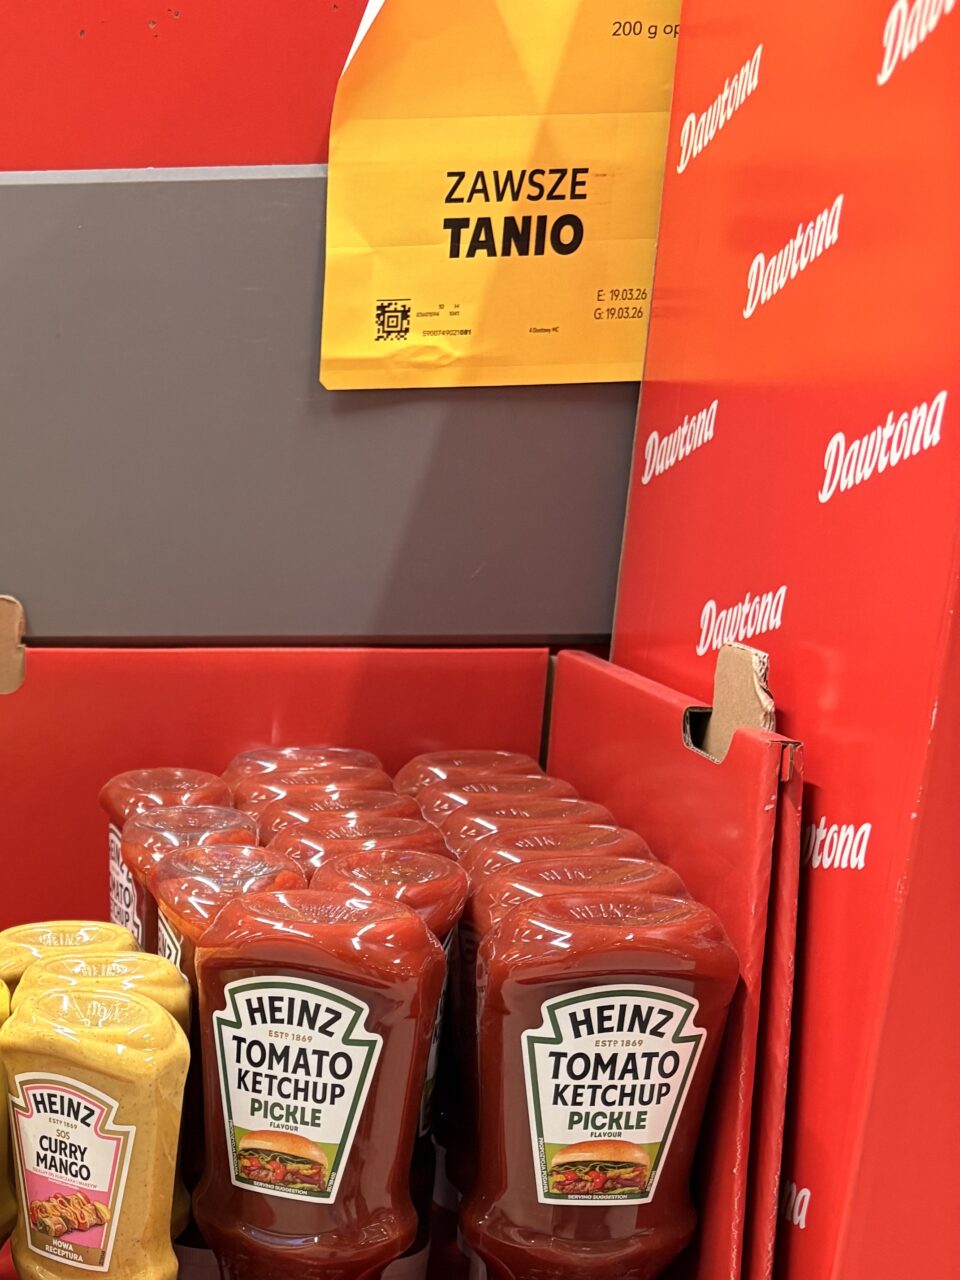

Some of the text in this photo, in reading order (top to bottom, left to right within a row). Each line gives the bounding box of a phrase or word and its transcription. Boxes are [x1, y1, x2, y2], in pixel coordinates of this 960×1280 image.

[612, 22, 642, 36] 200
[648, 26, 657, 38] g
[677, 44, 762, 174] Dawtona
[445, 168, 589, 204] ZAWSZE
[443, 213, 584, 259] TANIO
[743, 194, 843, 319] Dawtona
[610, 288, 647, 300] 19.03.26
[606, 307, 643, 319] 19.03.26
[642, 400, 718, 485] Dawtona
[818, 390, 947, 504] Dawtona
[696, 585, 787, 656] Dawtona
[803, 815, 872, 870] tona
[245, 996, 343, 1038] HEINZ
[568, 1004, 675, 1040] HEINZ
[232, 1034, 354, 1081] TOMATO
[620, 1039, 643, 1048] 1869
[548, 1050, 680, 1080] TOMATO
[237, 1068, 346, 1106] KETCHUP
[551, 1082, 671, 1107] KETCHUP
[32, 1093, 95, 1127] HEINZ
[250, 1098, 322, 1127] PICKLE
[568, 1111, 648, 1130] PICKLE
[56, 1129, 70, 1140] SOS
[270, 1122, 298, 1131] FLAVOUR
[39, 1135, 87, 1162] CURRY
[36, 1152, 91, 1181] MANGO
[45, 1244, 83, 1262] RECEPTURA
[53, 1239, 73, 1251] NOWA
